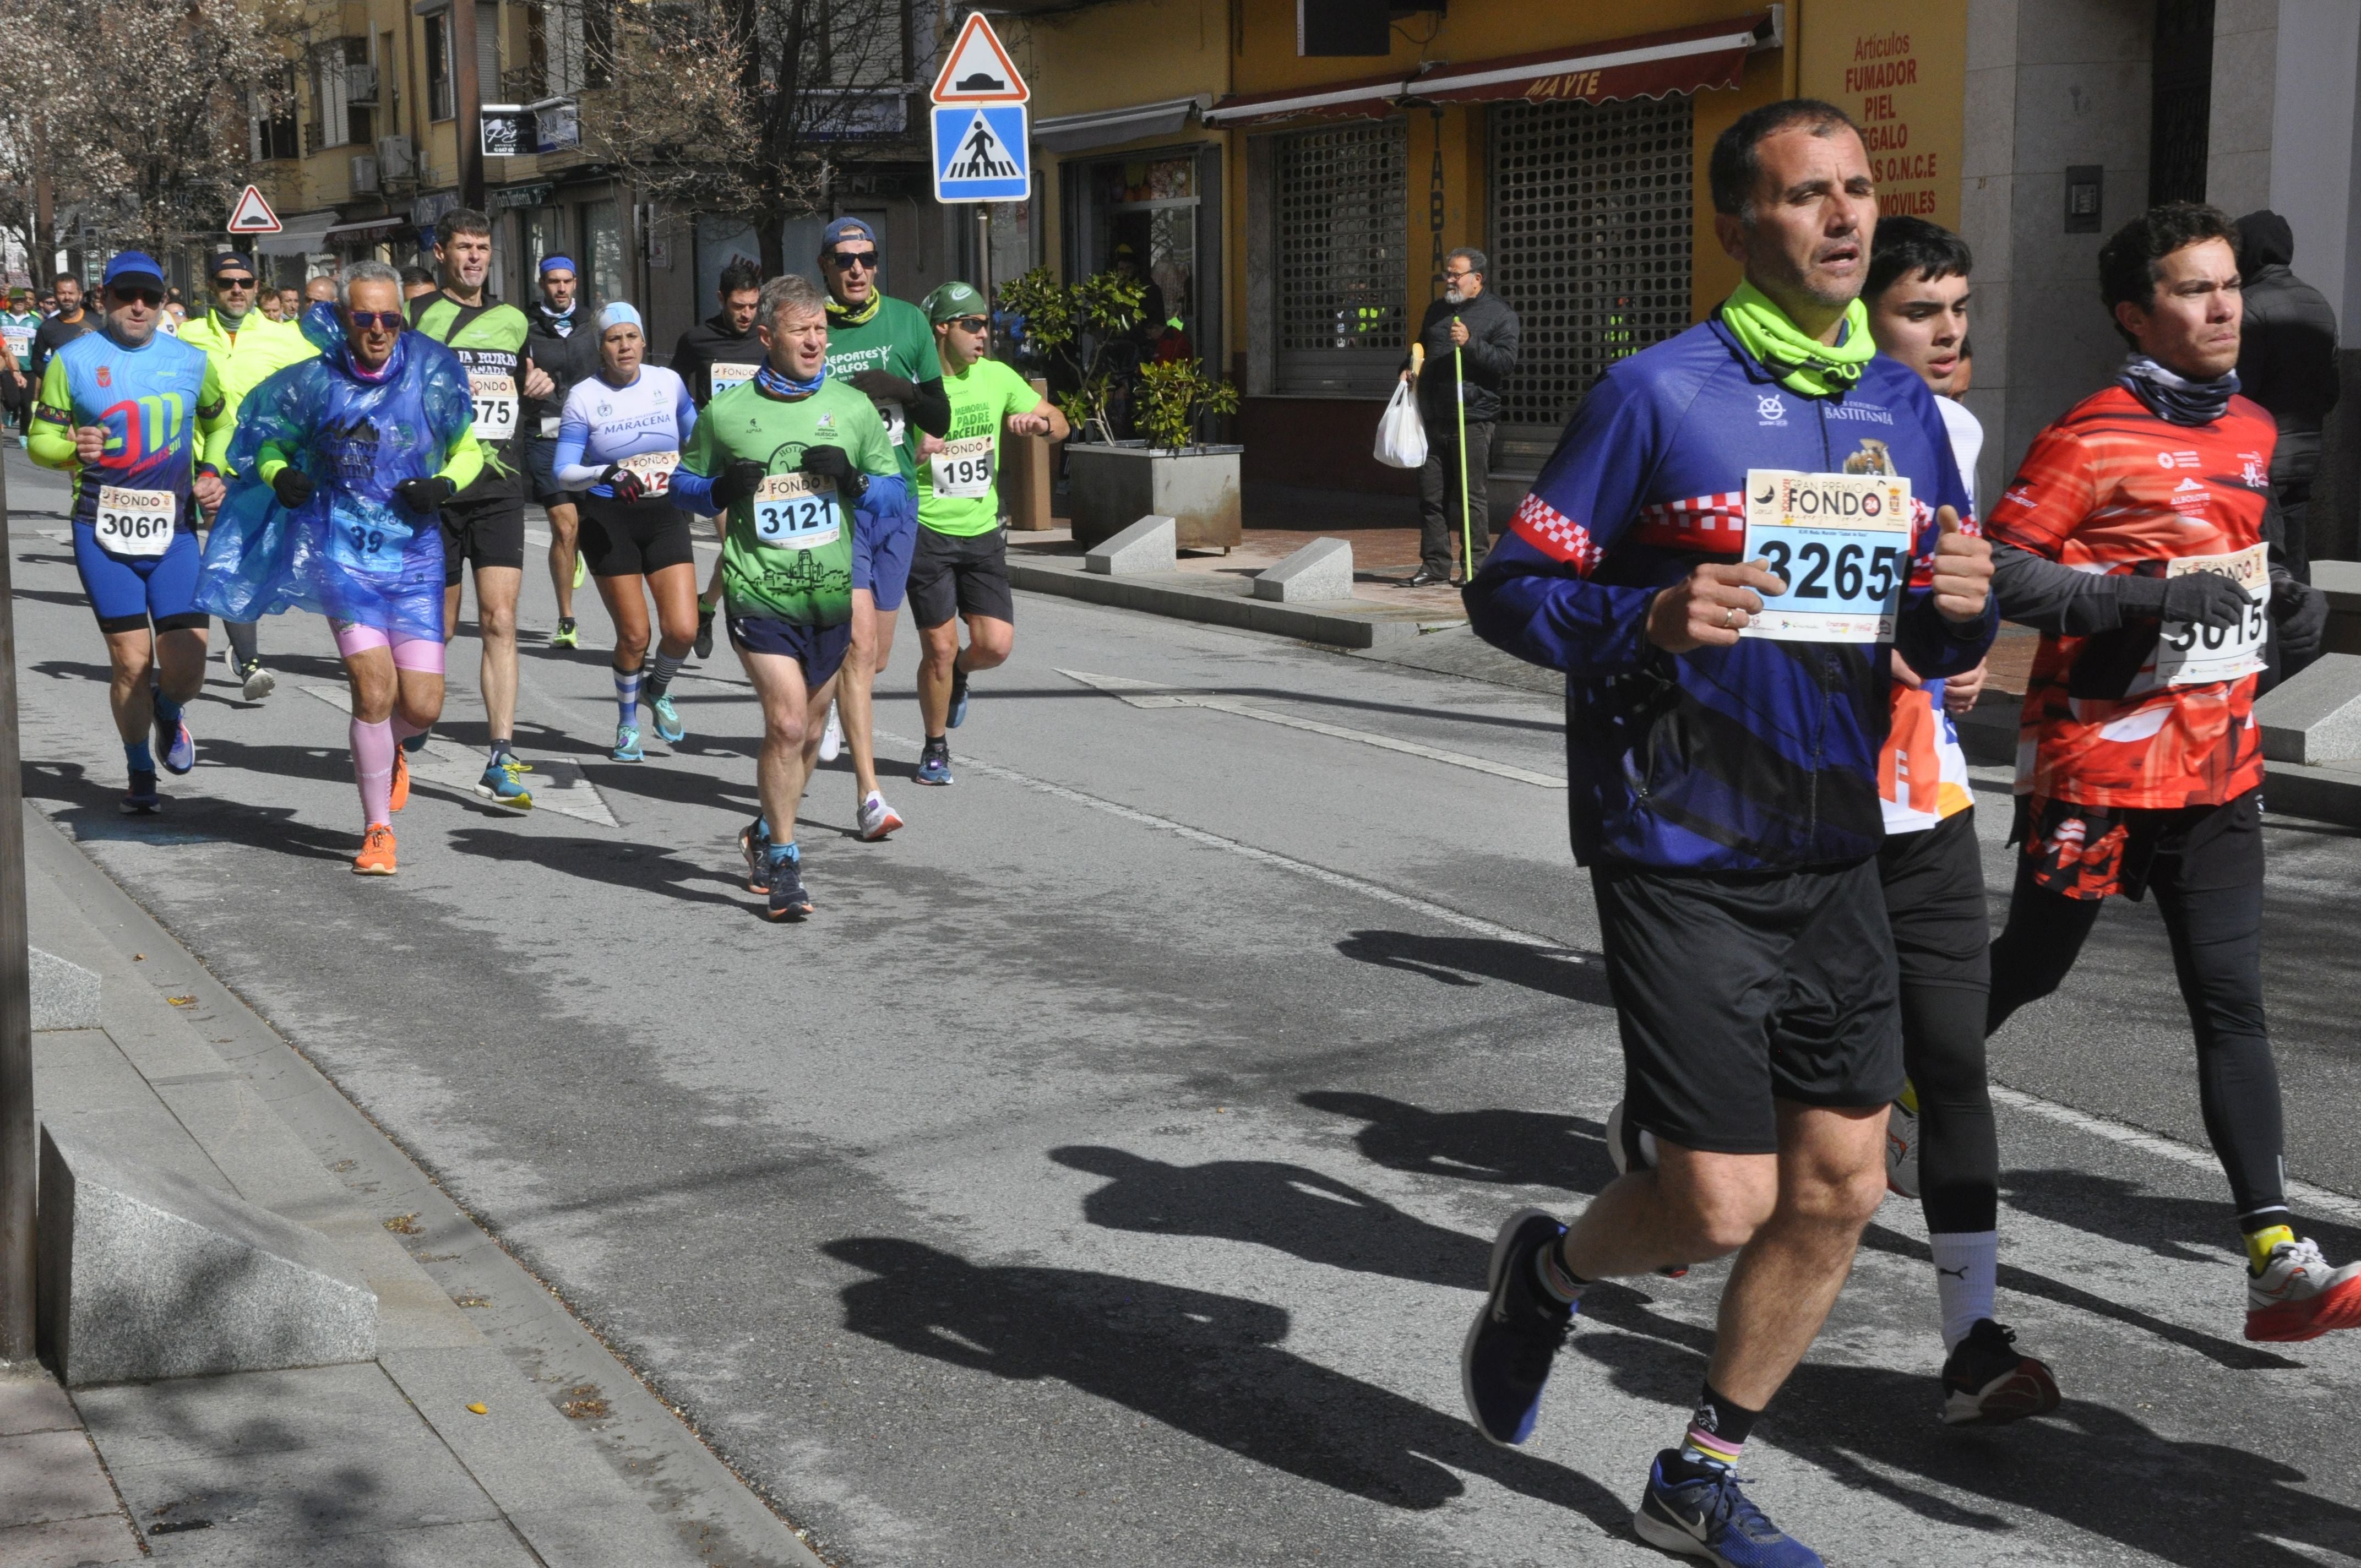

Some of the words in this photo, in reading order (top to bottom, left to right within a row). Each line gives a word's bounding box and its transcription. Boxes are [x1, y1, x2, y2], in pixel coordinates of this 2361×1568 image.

[1854, 31, 1910, 62] Artículos
[1524, 70, 1601, 97] MAYTE
[1846, 58, 1917, 94] FUMADOR
[1864, 94, 1896, 122] PIEL
[1978, 177, 1987, 189] 21
[1880, 188, 1935, 217] MÓVILES
[825, 349, 878, 364] EPORTES
[723, 368, 756, 376] FONDO
[475, 380, 507, 391] ONDO
[955, 402, 991, 416] MEMORIAL
[1824, 406, 1894, 426] BASTITANIA
[605, 414, 671, 435] MARACENA
[957, 411, 990, 428] PADRE
[945, 423, 994, 440] ARCELINO
[779, 445, 805, 458] HOTE
[946, 442, 983, 456] FONDO
[634, 456, 669, 467] FONDO
[943, 458, 988, 484] 195
[771, 477, 820, 494] FONDO
[1789, 478, 1818, 491] GRAN
[1822, 481, 1864, 494] PREMIO
[114, 494, 160, 507] FONDO
[1789, 488, 1881, 517] FONDO
[761, 498, 832, 534] 3121
[102, 513, 168, 538] 3060
[350, 525, 385, 554] 39
[1758, 540, 1897, 602] 3265
